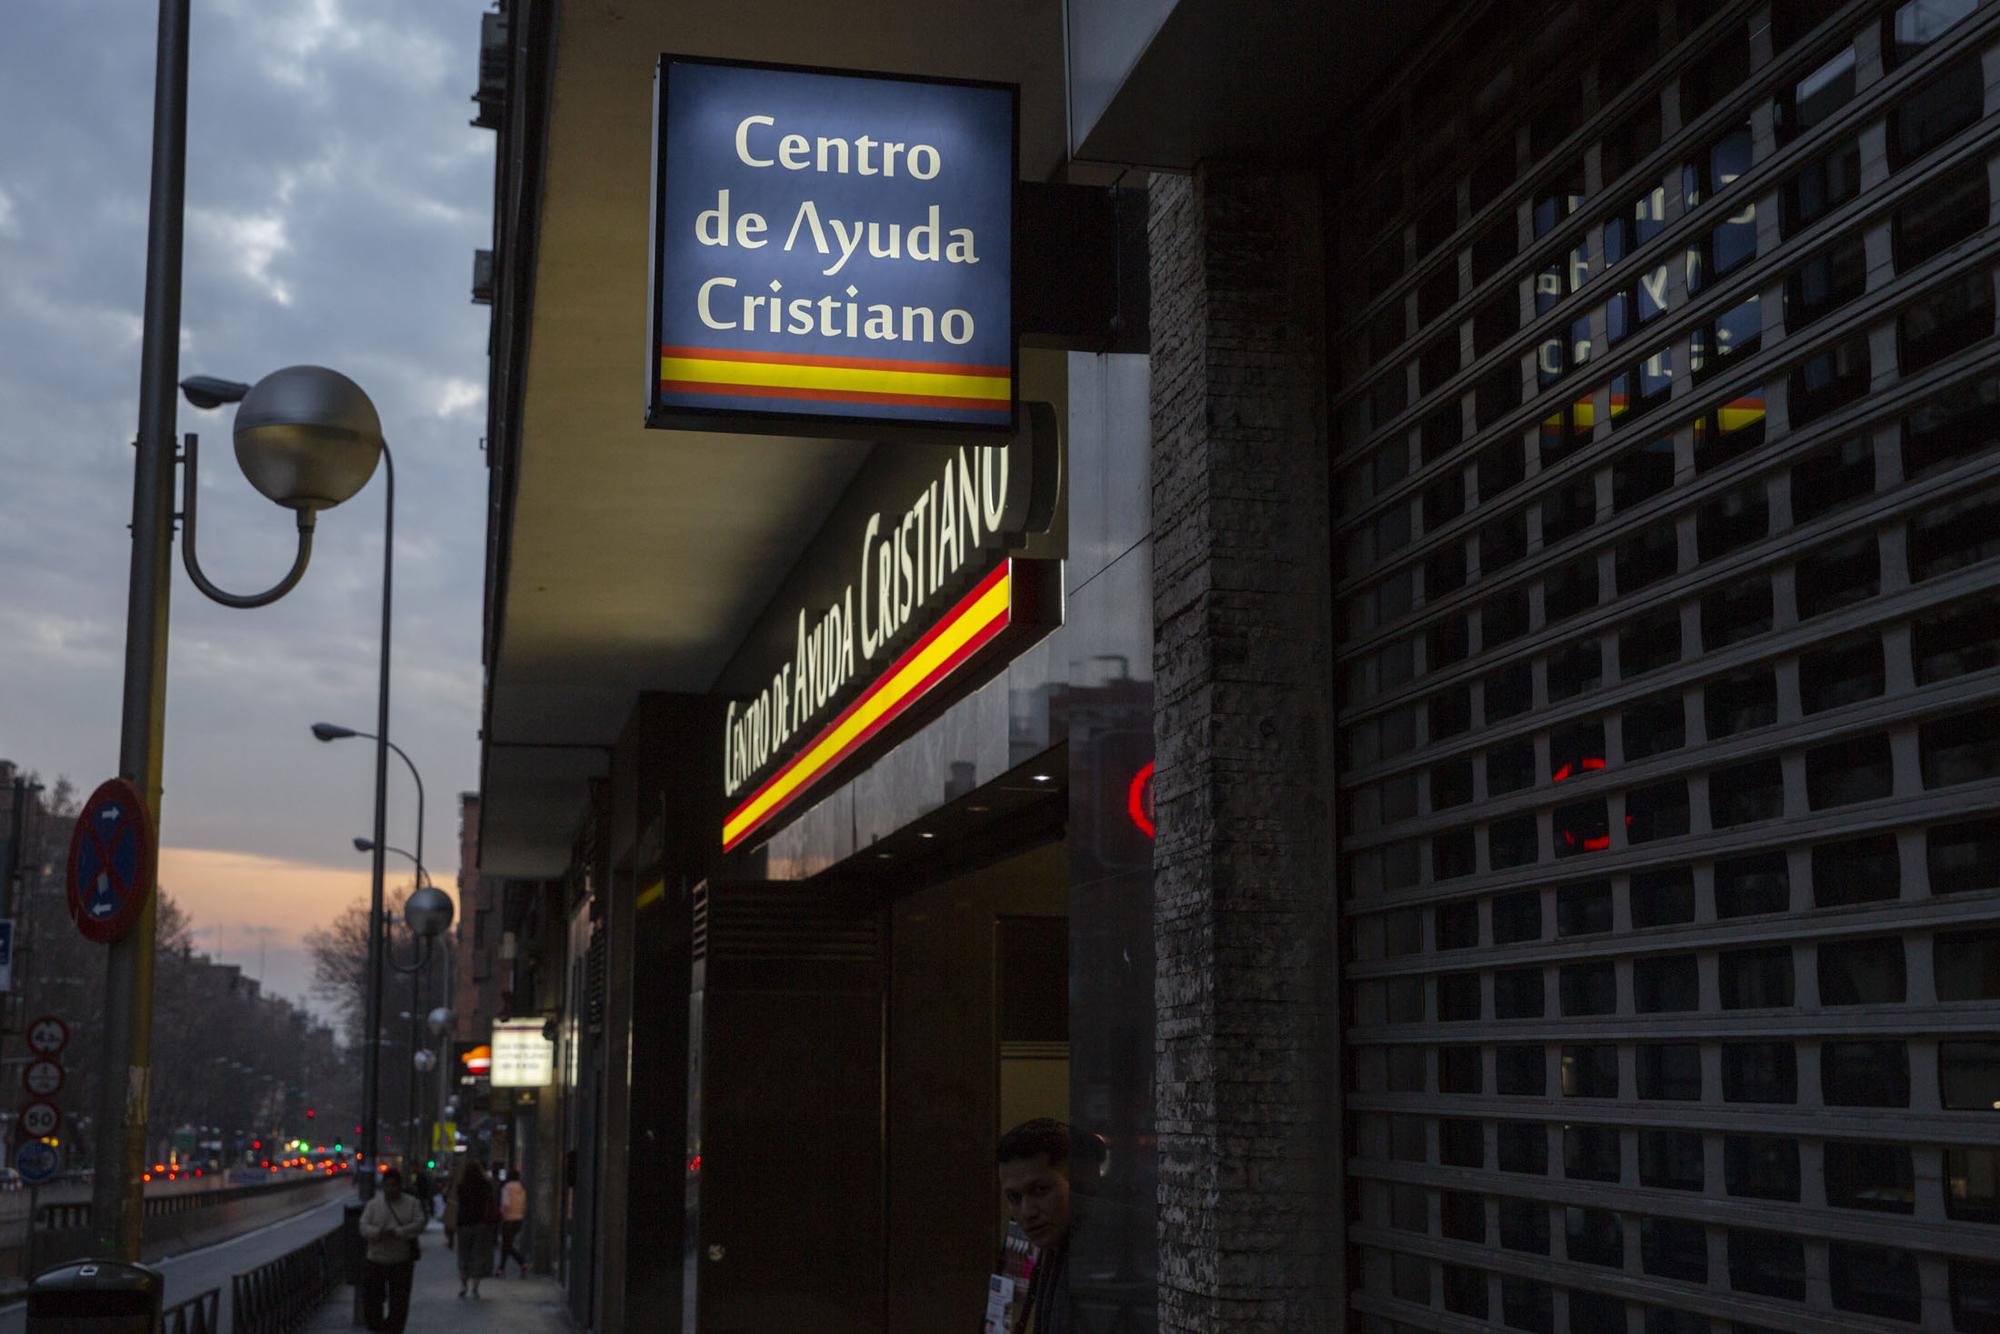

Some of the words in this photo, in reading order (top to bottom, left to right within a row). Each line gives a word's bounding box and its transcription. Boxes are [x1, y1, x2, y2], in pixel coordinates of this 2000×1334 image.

[735, 115, 941, 180] Centro
[695, 188, 768, 249] de
[784, 200, 980, 276] Ayuda
[697, 277, 975, 345] Cristiano
[28, 1113, 52, 1127] 50
